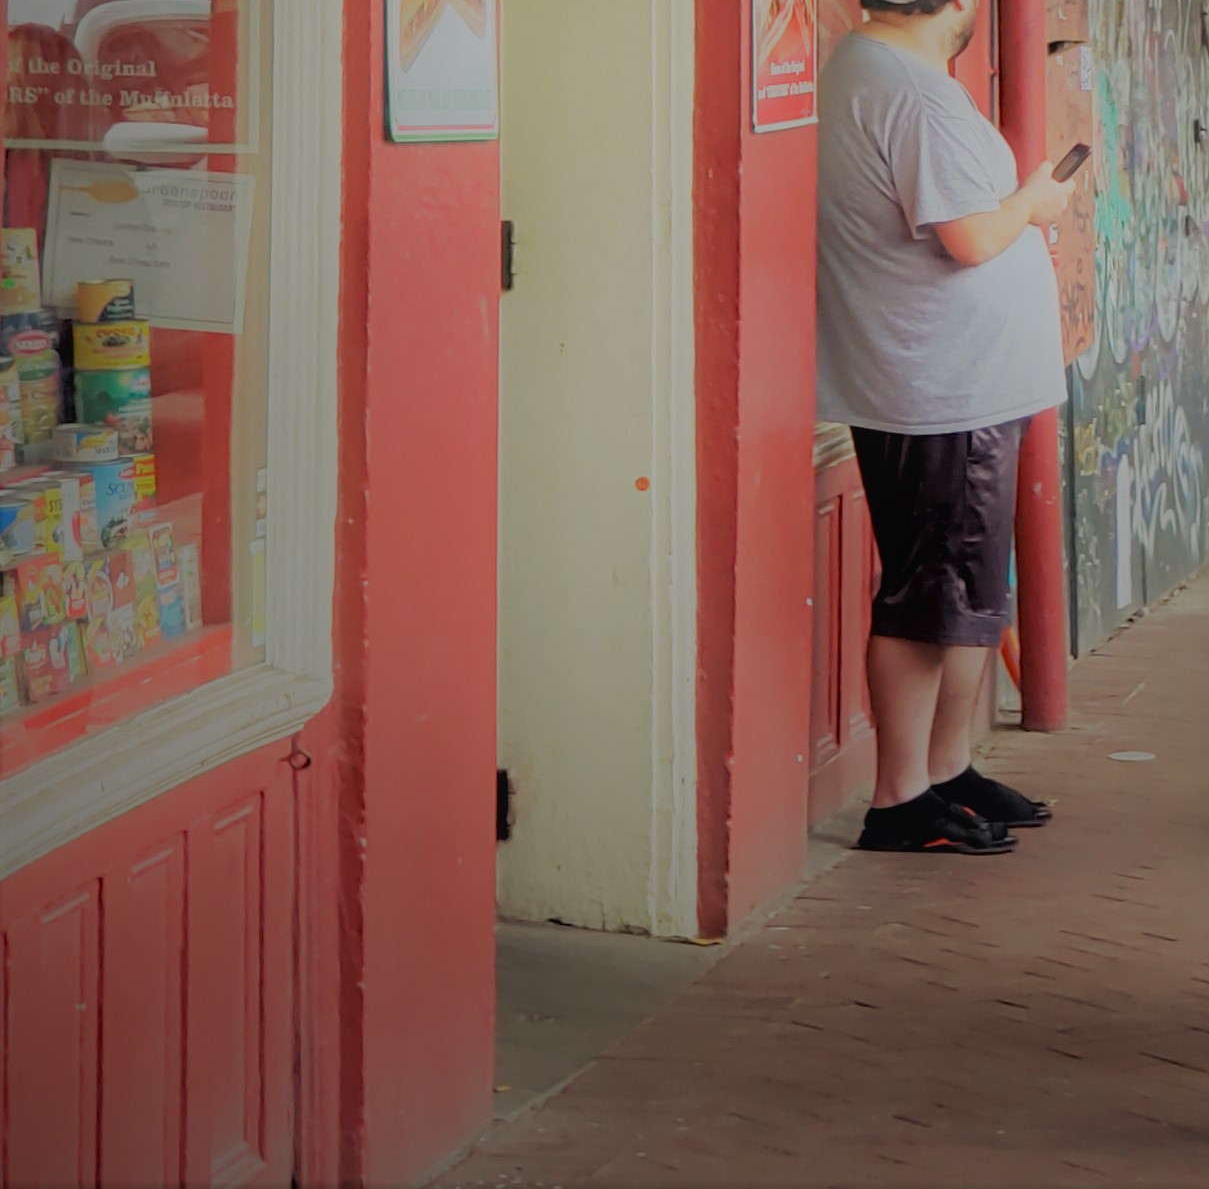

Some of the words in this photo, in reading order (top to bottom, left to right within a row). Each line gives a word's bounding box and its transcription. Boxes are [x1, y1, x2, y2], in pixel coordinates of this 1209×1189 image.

[28, 58, 60, 74] the
[67, 59, 156, 79] Original
[54, 88, 76, 104] of
[80, 90, 113, 106] the
